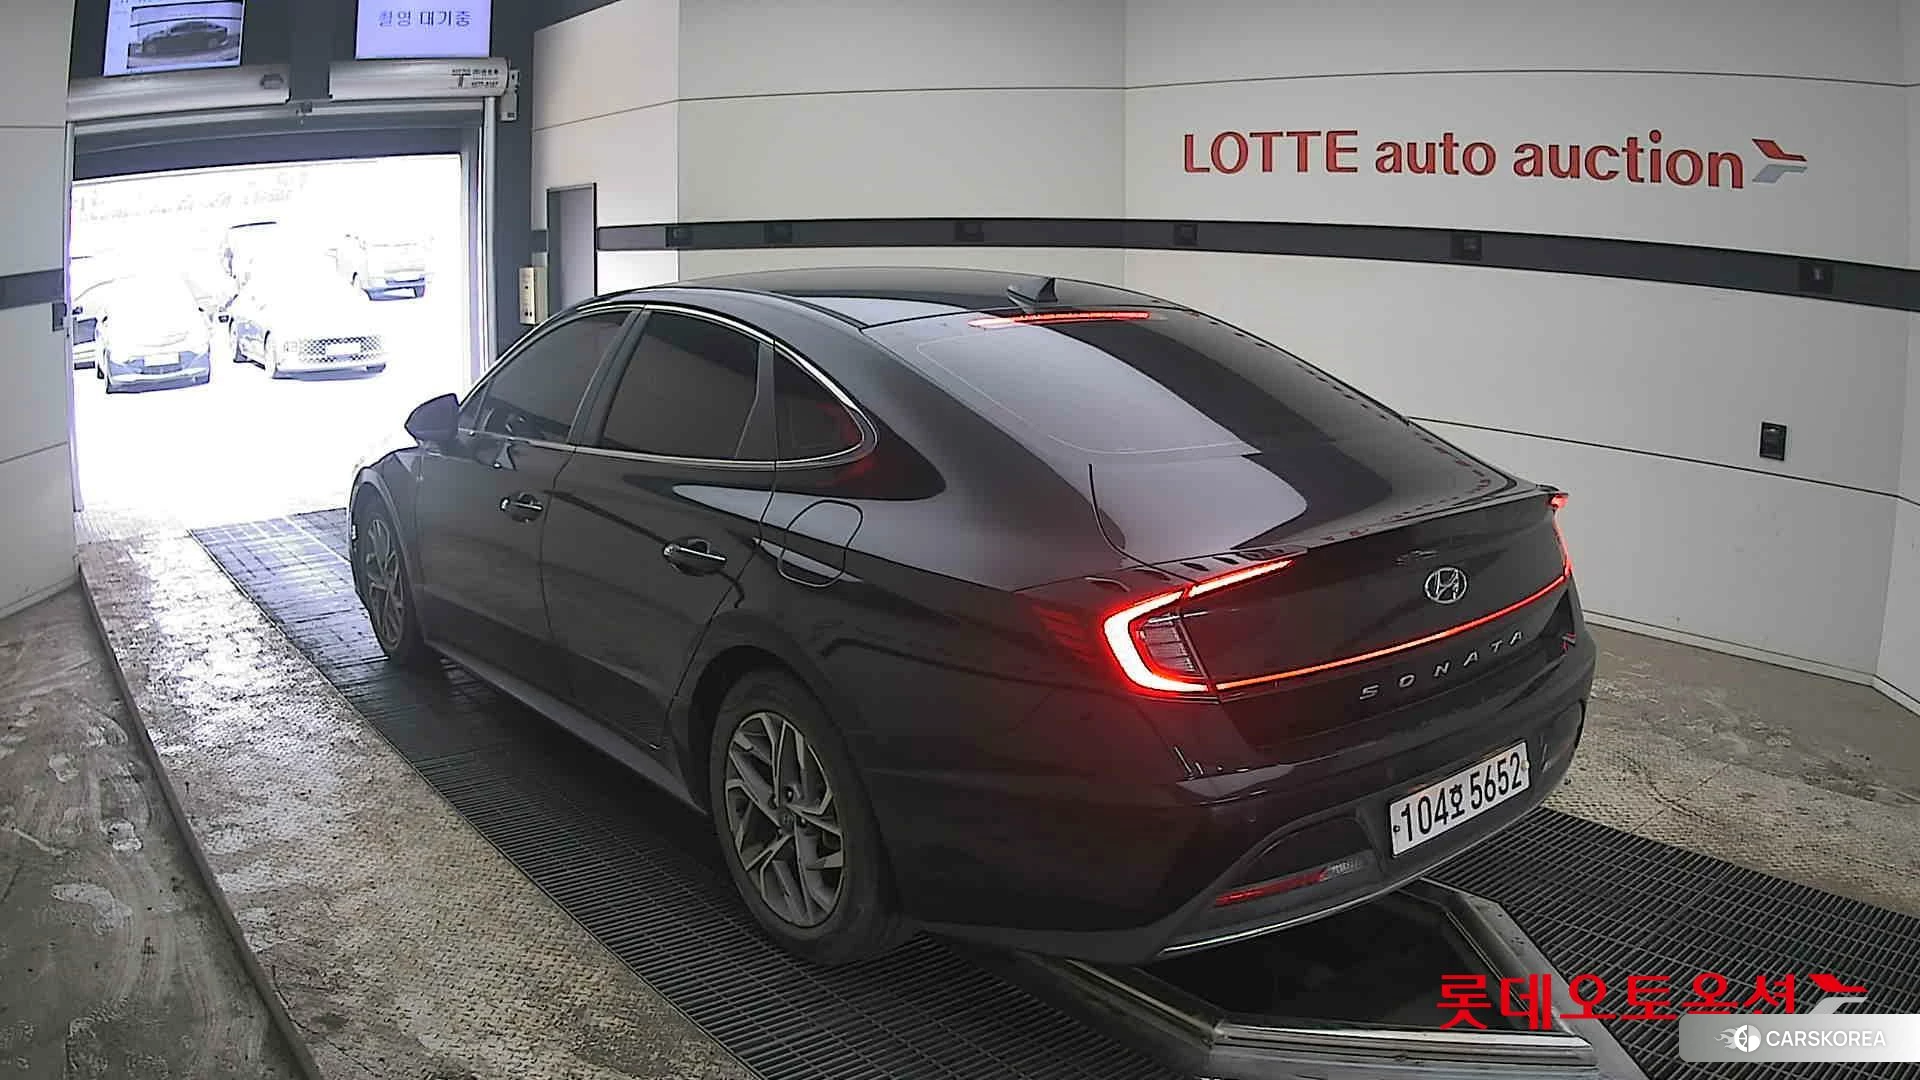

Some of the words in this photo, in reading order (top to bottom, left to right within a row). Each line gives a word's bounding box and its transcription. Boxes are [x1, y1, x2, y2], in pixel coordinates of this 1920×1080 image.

[419, 10, 472, 27] 대기중
[1184, 130, 1358, 174] LOTTE
[1375, 132, 1497, 176] auto
[1513, 131, 1744, 189] auction
[1359, 630, 1523, 700] SONATA
[1400, 783, 1466, 842] 104호
[1469, 751, 1523, 810] 5652
